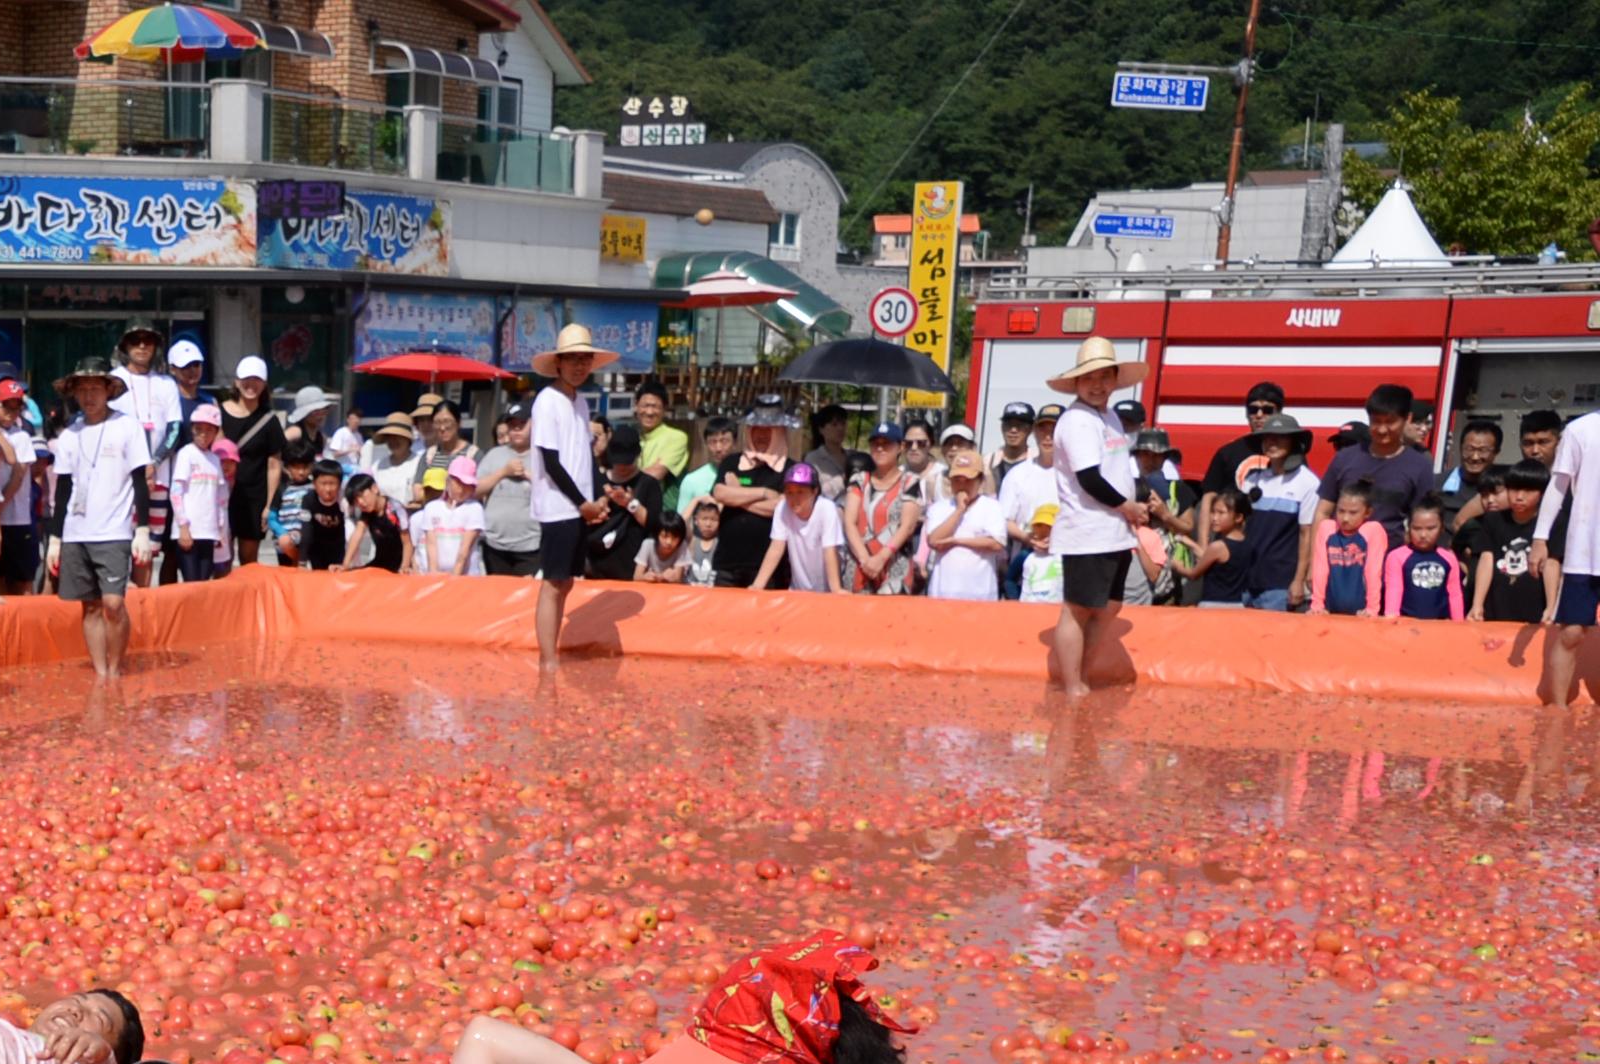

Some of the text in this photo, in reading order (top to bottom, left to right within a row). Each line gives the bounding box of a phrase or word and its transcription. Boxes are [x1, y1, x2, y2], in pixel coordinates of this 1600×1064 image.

[623, 96, 688, 118] 산수장
[645, 127, 701, 144] 산수장
[880, 300, 908, 324] 30
[913, 248, 947, 360] 섬뜰마
